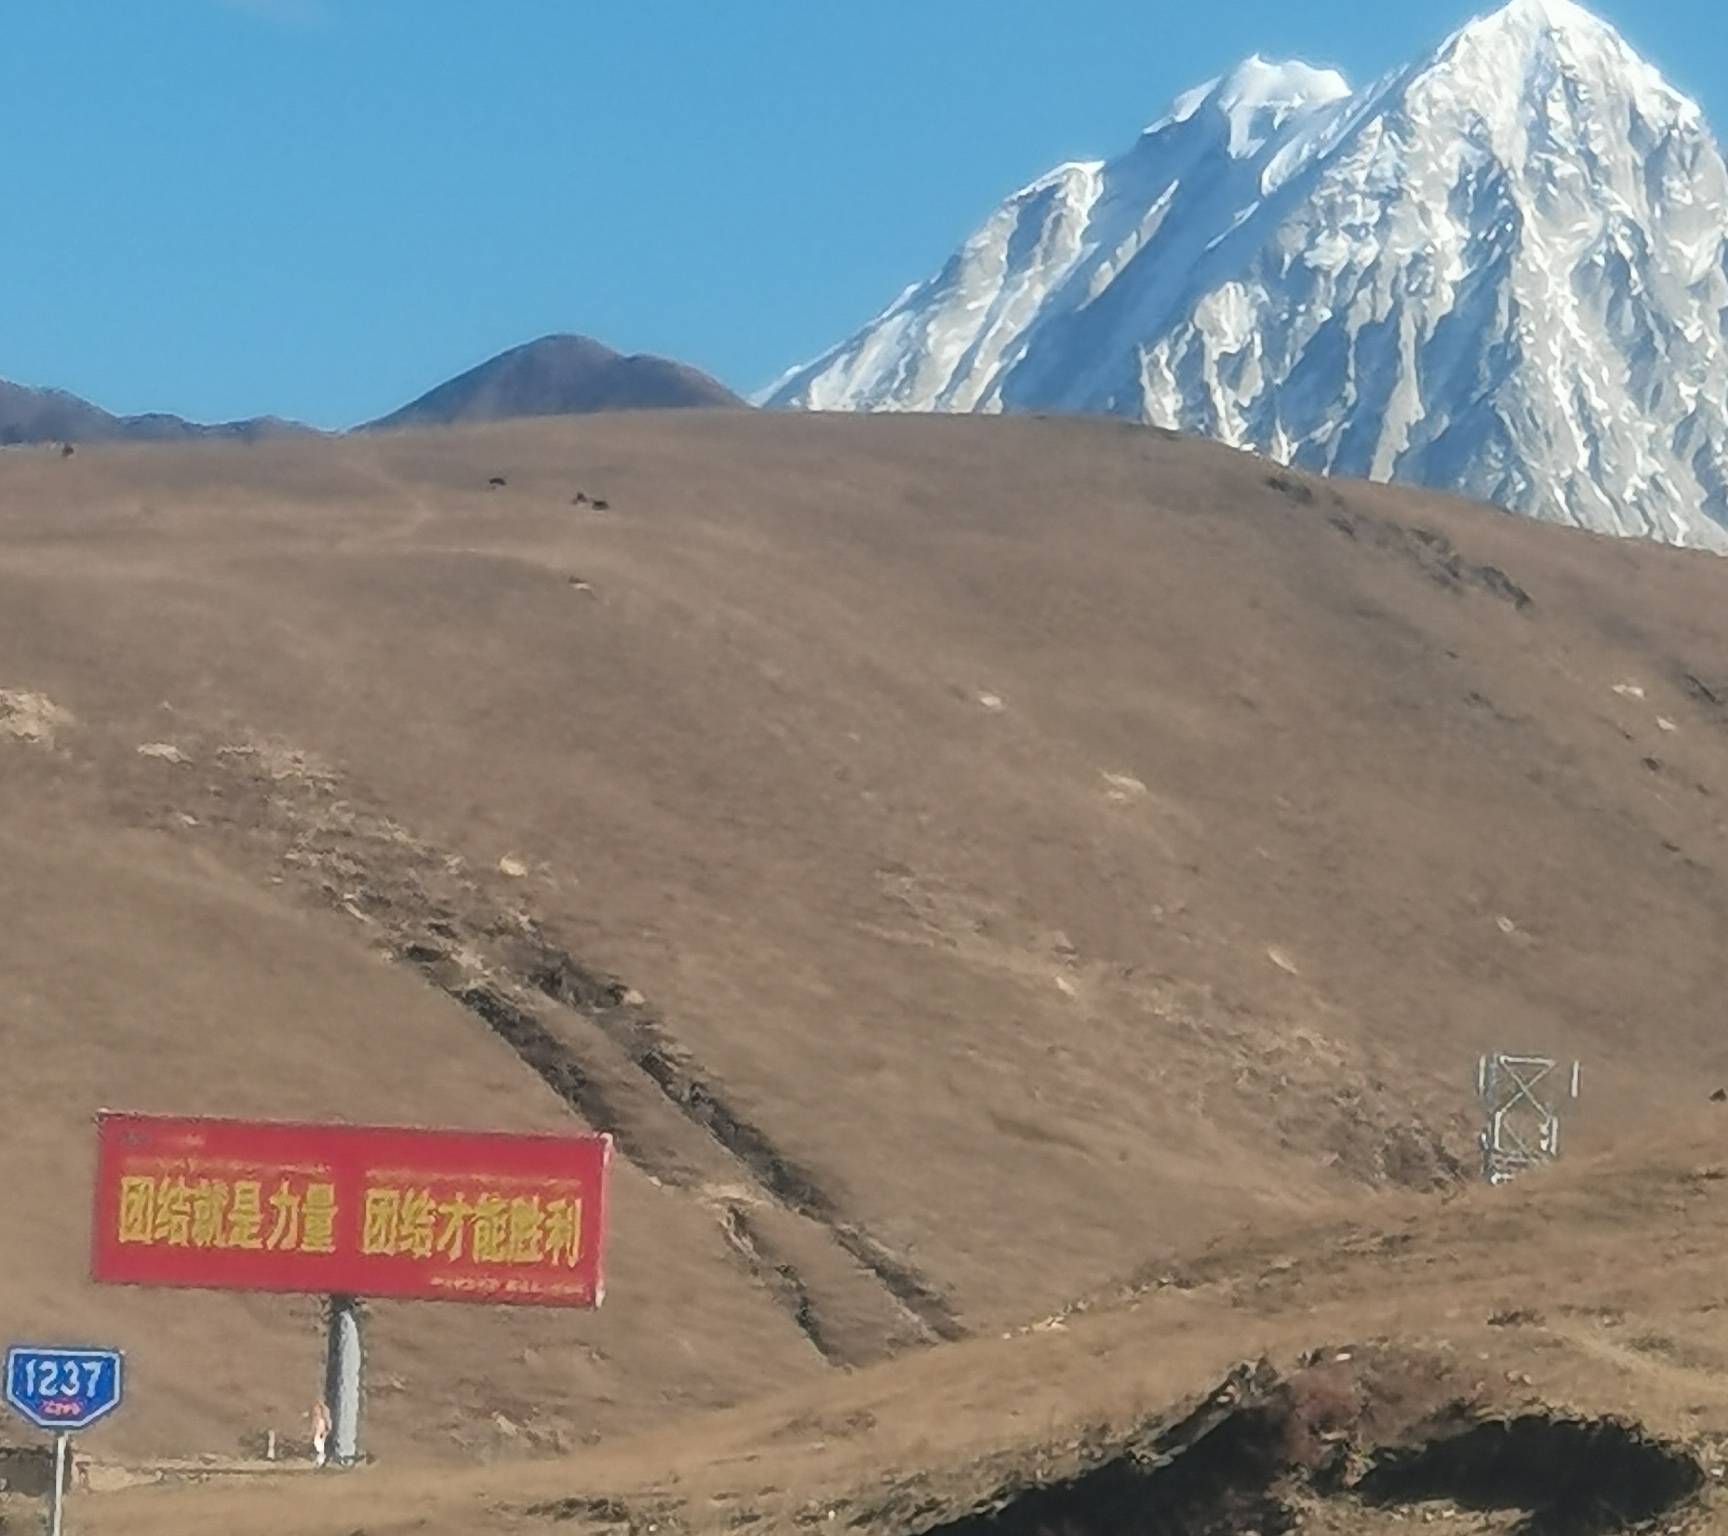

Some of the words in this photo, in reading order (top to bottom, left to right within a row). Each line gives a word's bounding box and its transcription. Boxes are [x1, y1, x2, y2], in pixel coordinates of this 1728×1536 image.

[118, 1175, 337, 1254] 团结就是力量
[361, 1187, 581, 1267] 团结才能胜利
[25, 1359, 104, 1398] 1237
